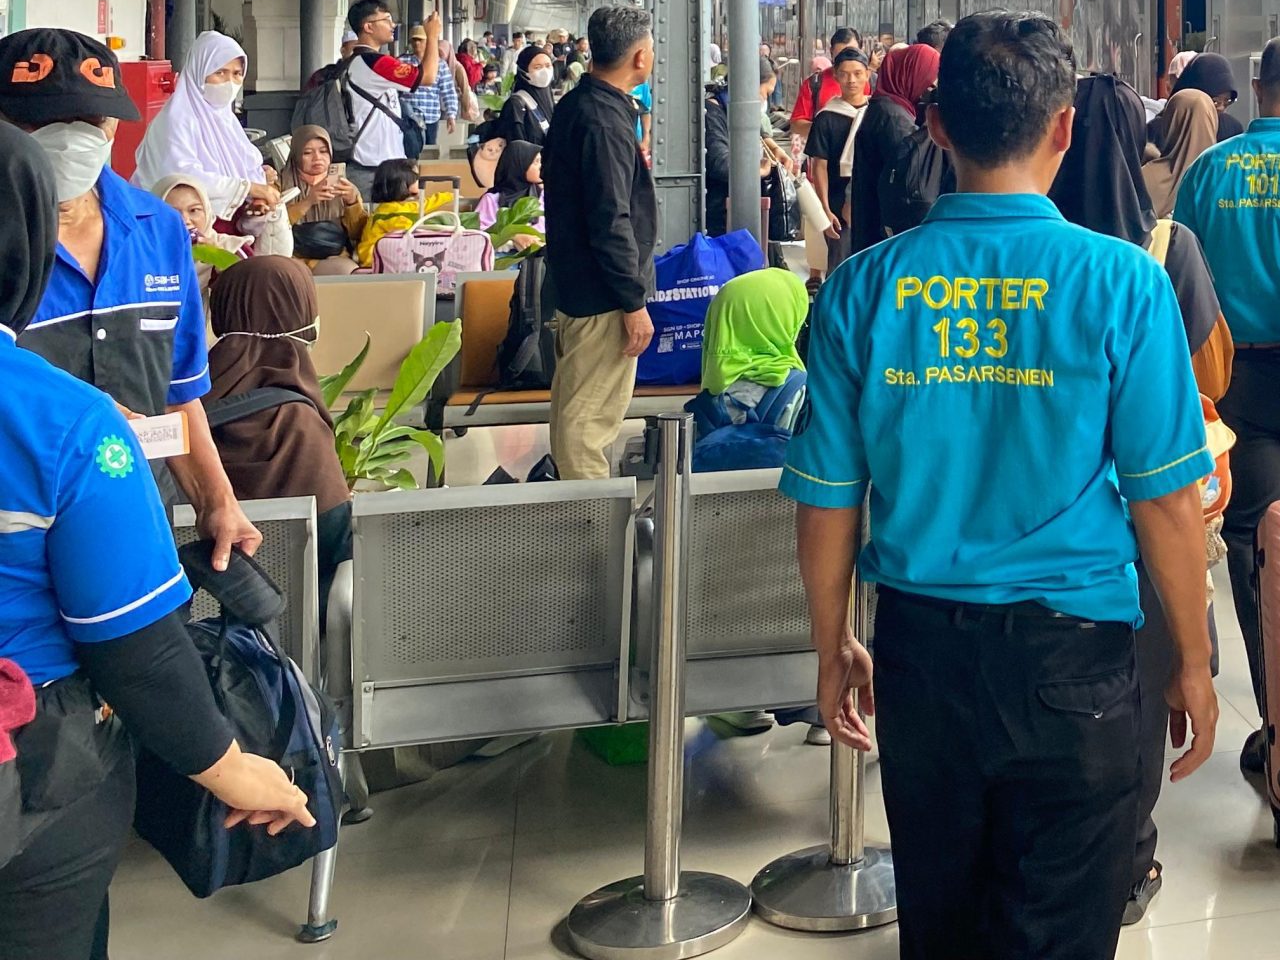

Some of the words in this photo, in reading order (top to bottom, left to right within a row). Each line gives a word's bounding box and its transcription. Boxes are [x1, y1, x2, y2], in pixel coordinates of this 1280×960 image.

[1246, 173, 1279, 195] 101
[895, 275, 1049, 311] PORTER
[932, 317, 1008, 359] 133
[884, 367, 921, 385] Sta.
[925, 364, 1054, 387] PASARSENEN
